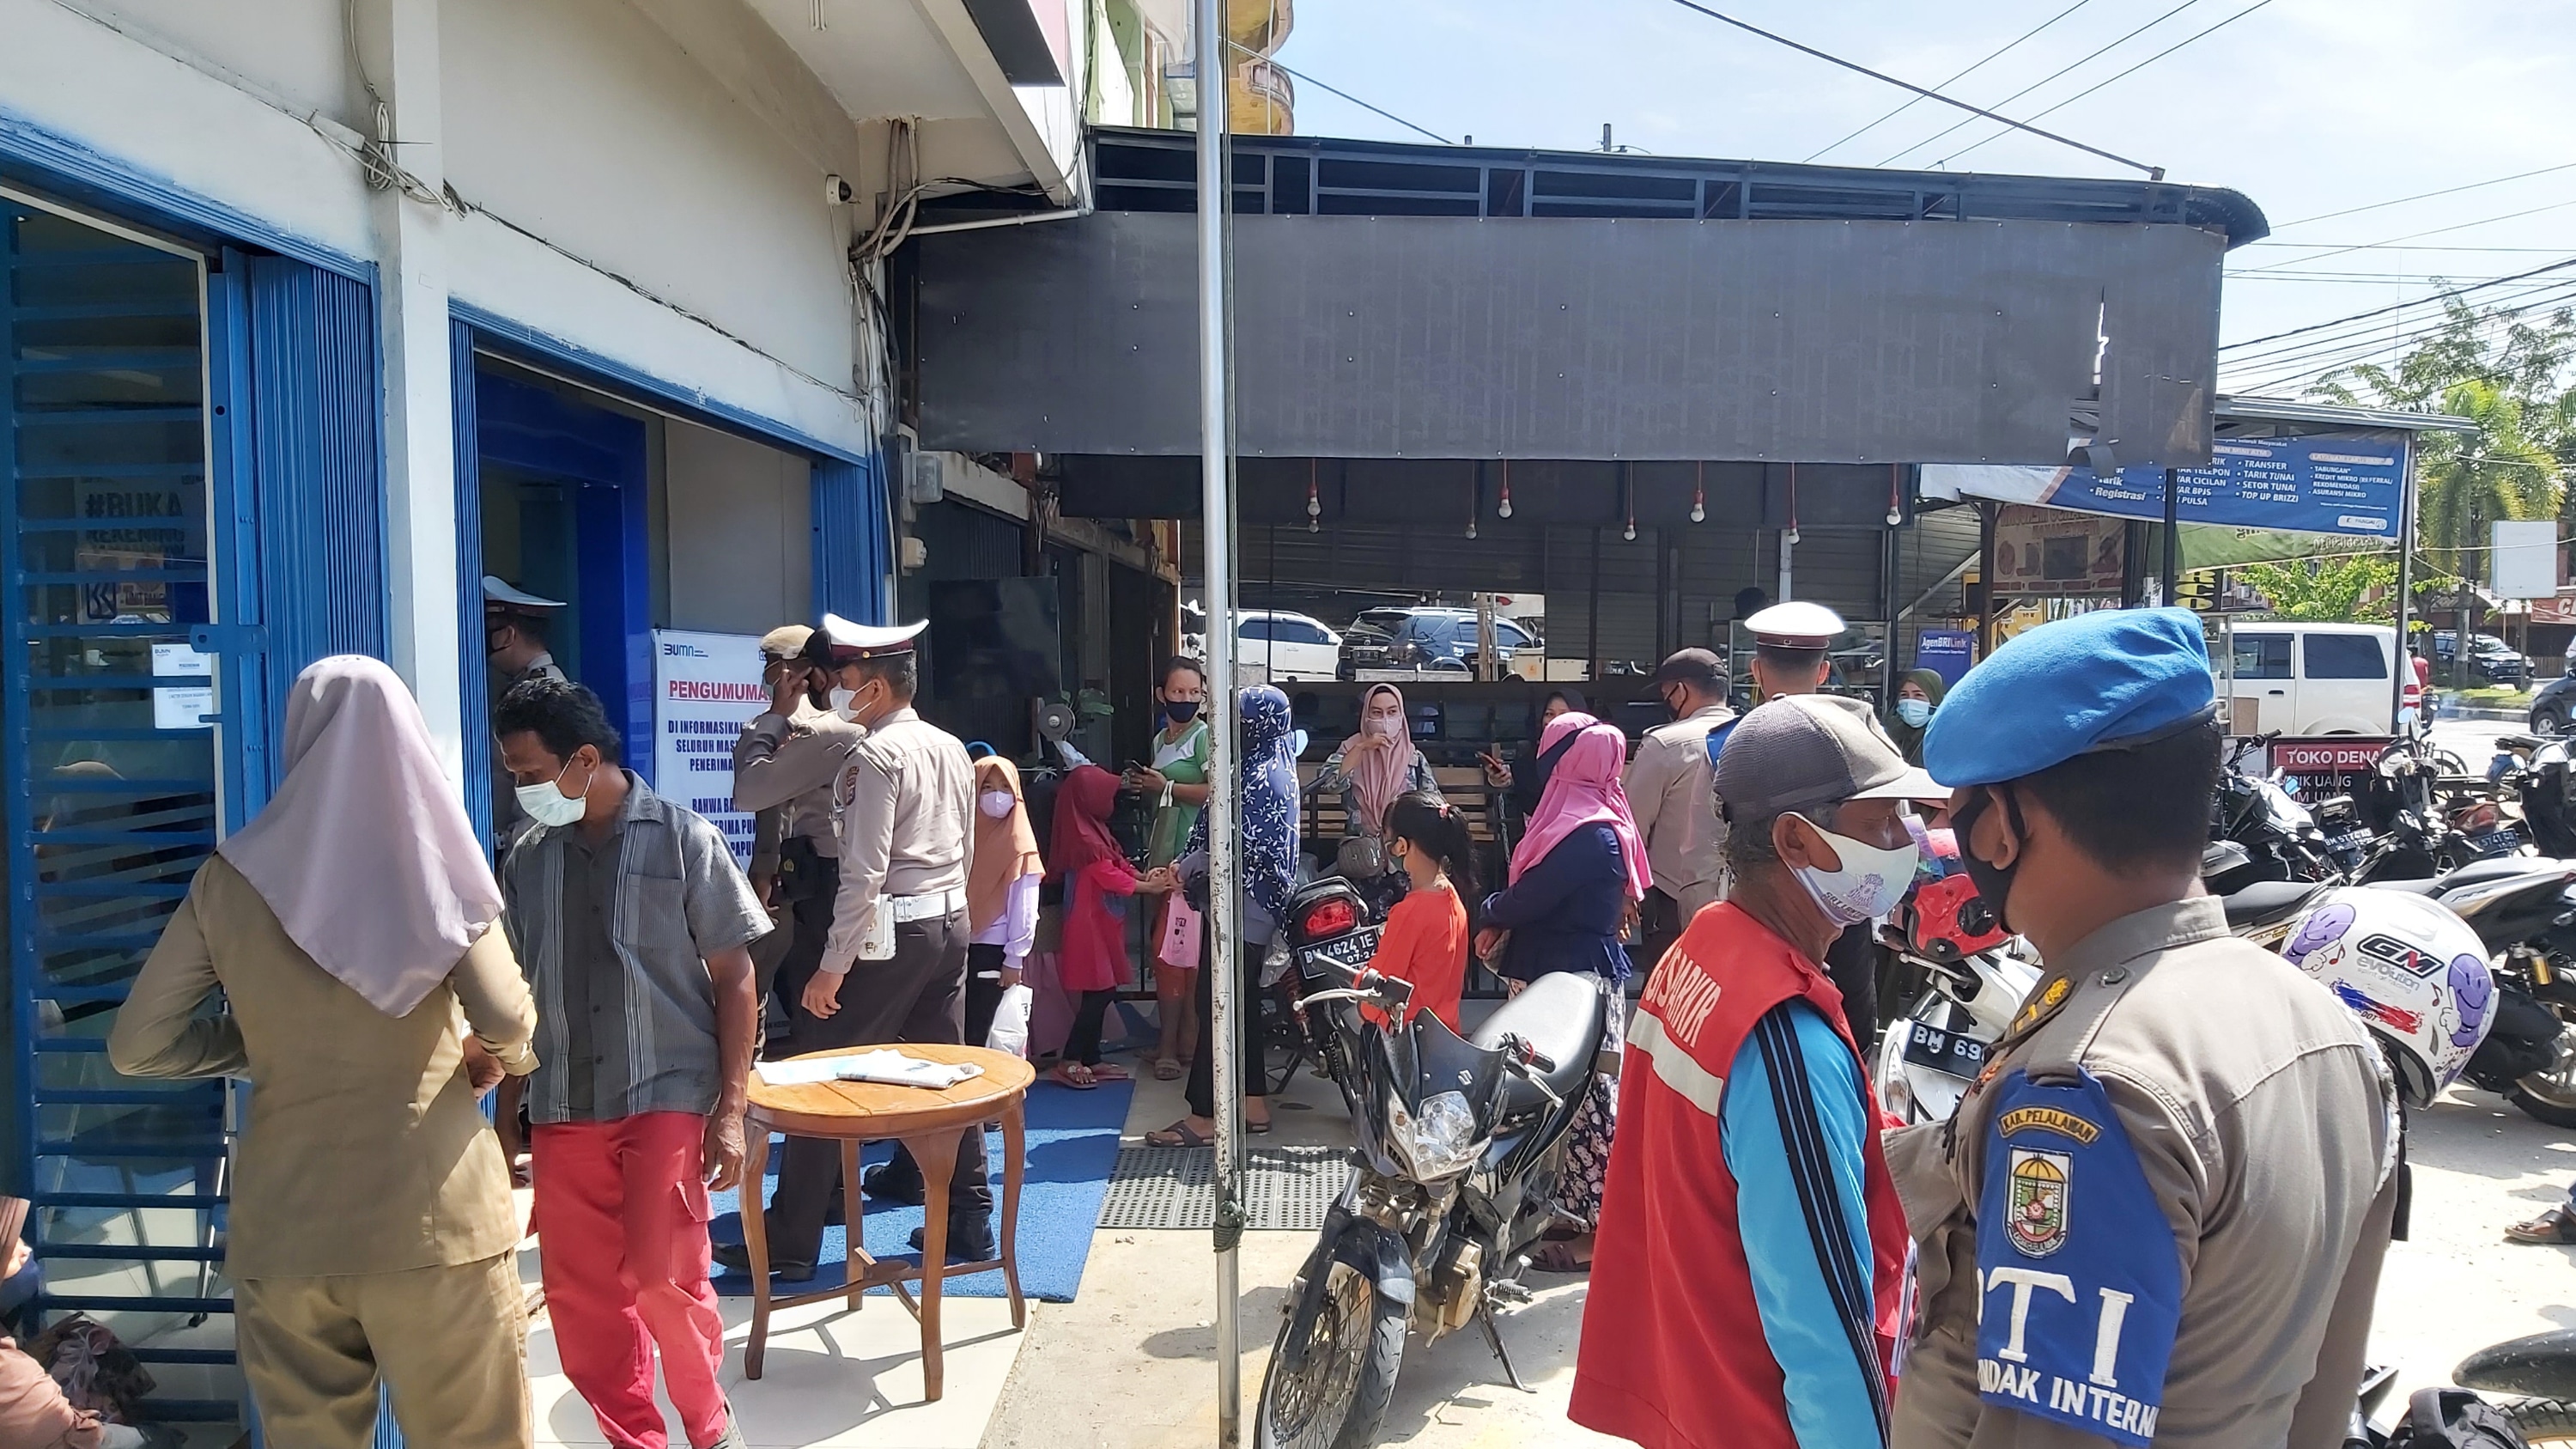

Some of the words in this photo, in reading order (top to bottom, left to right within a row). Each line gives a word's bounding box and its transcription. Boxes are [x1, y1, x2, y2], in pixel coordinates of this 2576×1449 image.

[2245, 460, 2287, 470] TRANSFER
[2193, 478, 2227, 487] CICILAN
[2244, 470, 2268, 479] TARIK
[2269, 472, 2294, 481] TUNAI
[2192, 487, 2212, 496] BPJS
[2243, 481, 2269, 490] SETOR
[2271, 483, 2297, 492] TUNAI
[2095, 487, 2147, 501] Registrasi
[2242, 491, 2258, 500] TOP
[2260, 492, 2272, 501] UP
[2273, 494, 2300, 503] BRIZZI
[2182, 497, 2208, 507] PULSA
[2558, 598, 2576, 615] C
[664, 643, 694, 656] BUMN
[1922, 636, 1967, 649] AgenBRILink
[669, 680, 772, 701] PENGUMUMA
[668, 720, 678, 734] DI
[676, 739, 714, 753] SELURUH
[2287, 747, 2333, 764] TOKO
[690, 758, 734, 772] PENERIMA
[692, 798, 721, 813] BAHWA
[1327, 938, 1358, 958] 4624
[1359, 933, 1375, 949] IE
[2360, 935, 2441, 976] GM
[2360, 1011, 2379, 1021] DOT
[1913, 1026, 1946, 1050] BM
[1953, 1038, 1984, 1063] 69
[2026, 1110, 2093, 1142] PELALAWAN
[1978, 1267, 2135, 1390] TI
